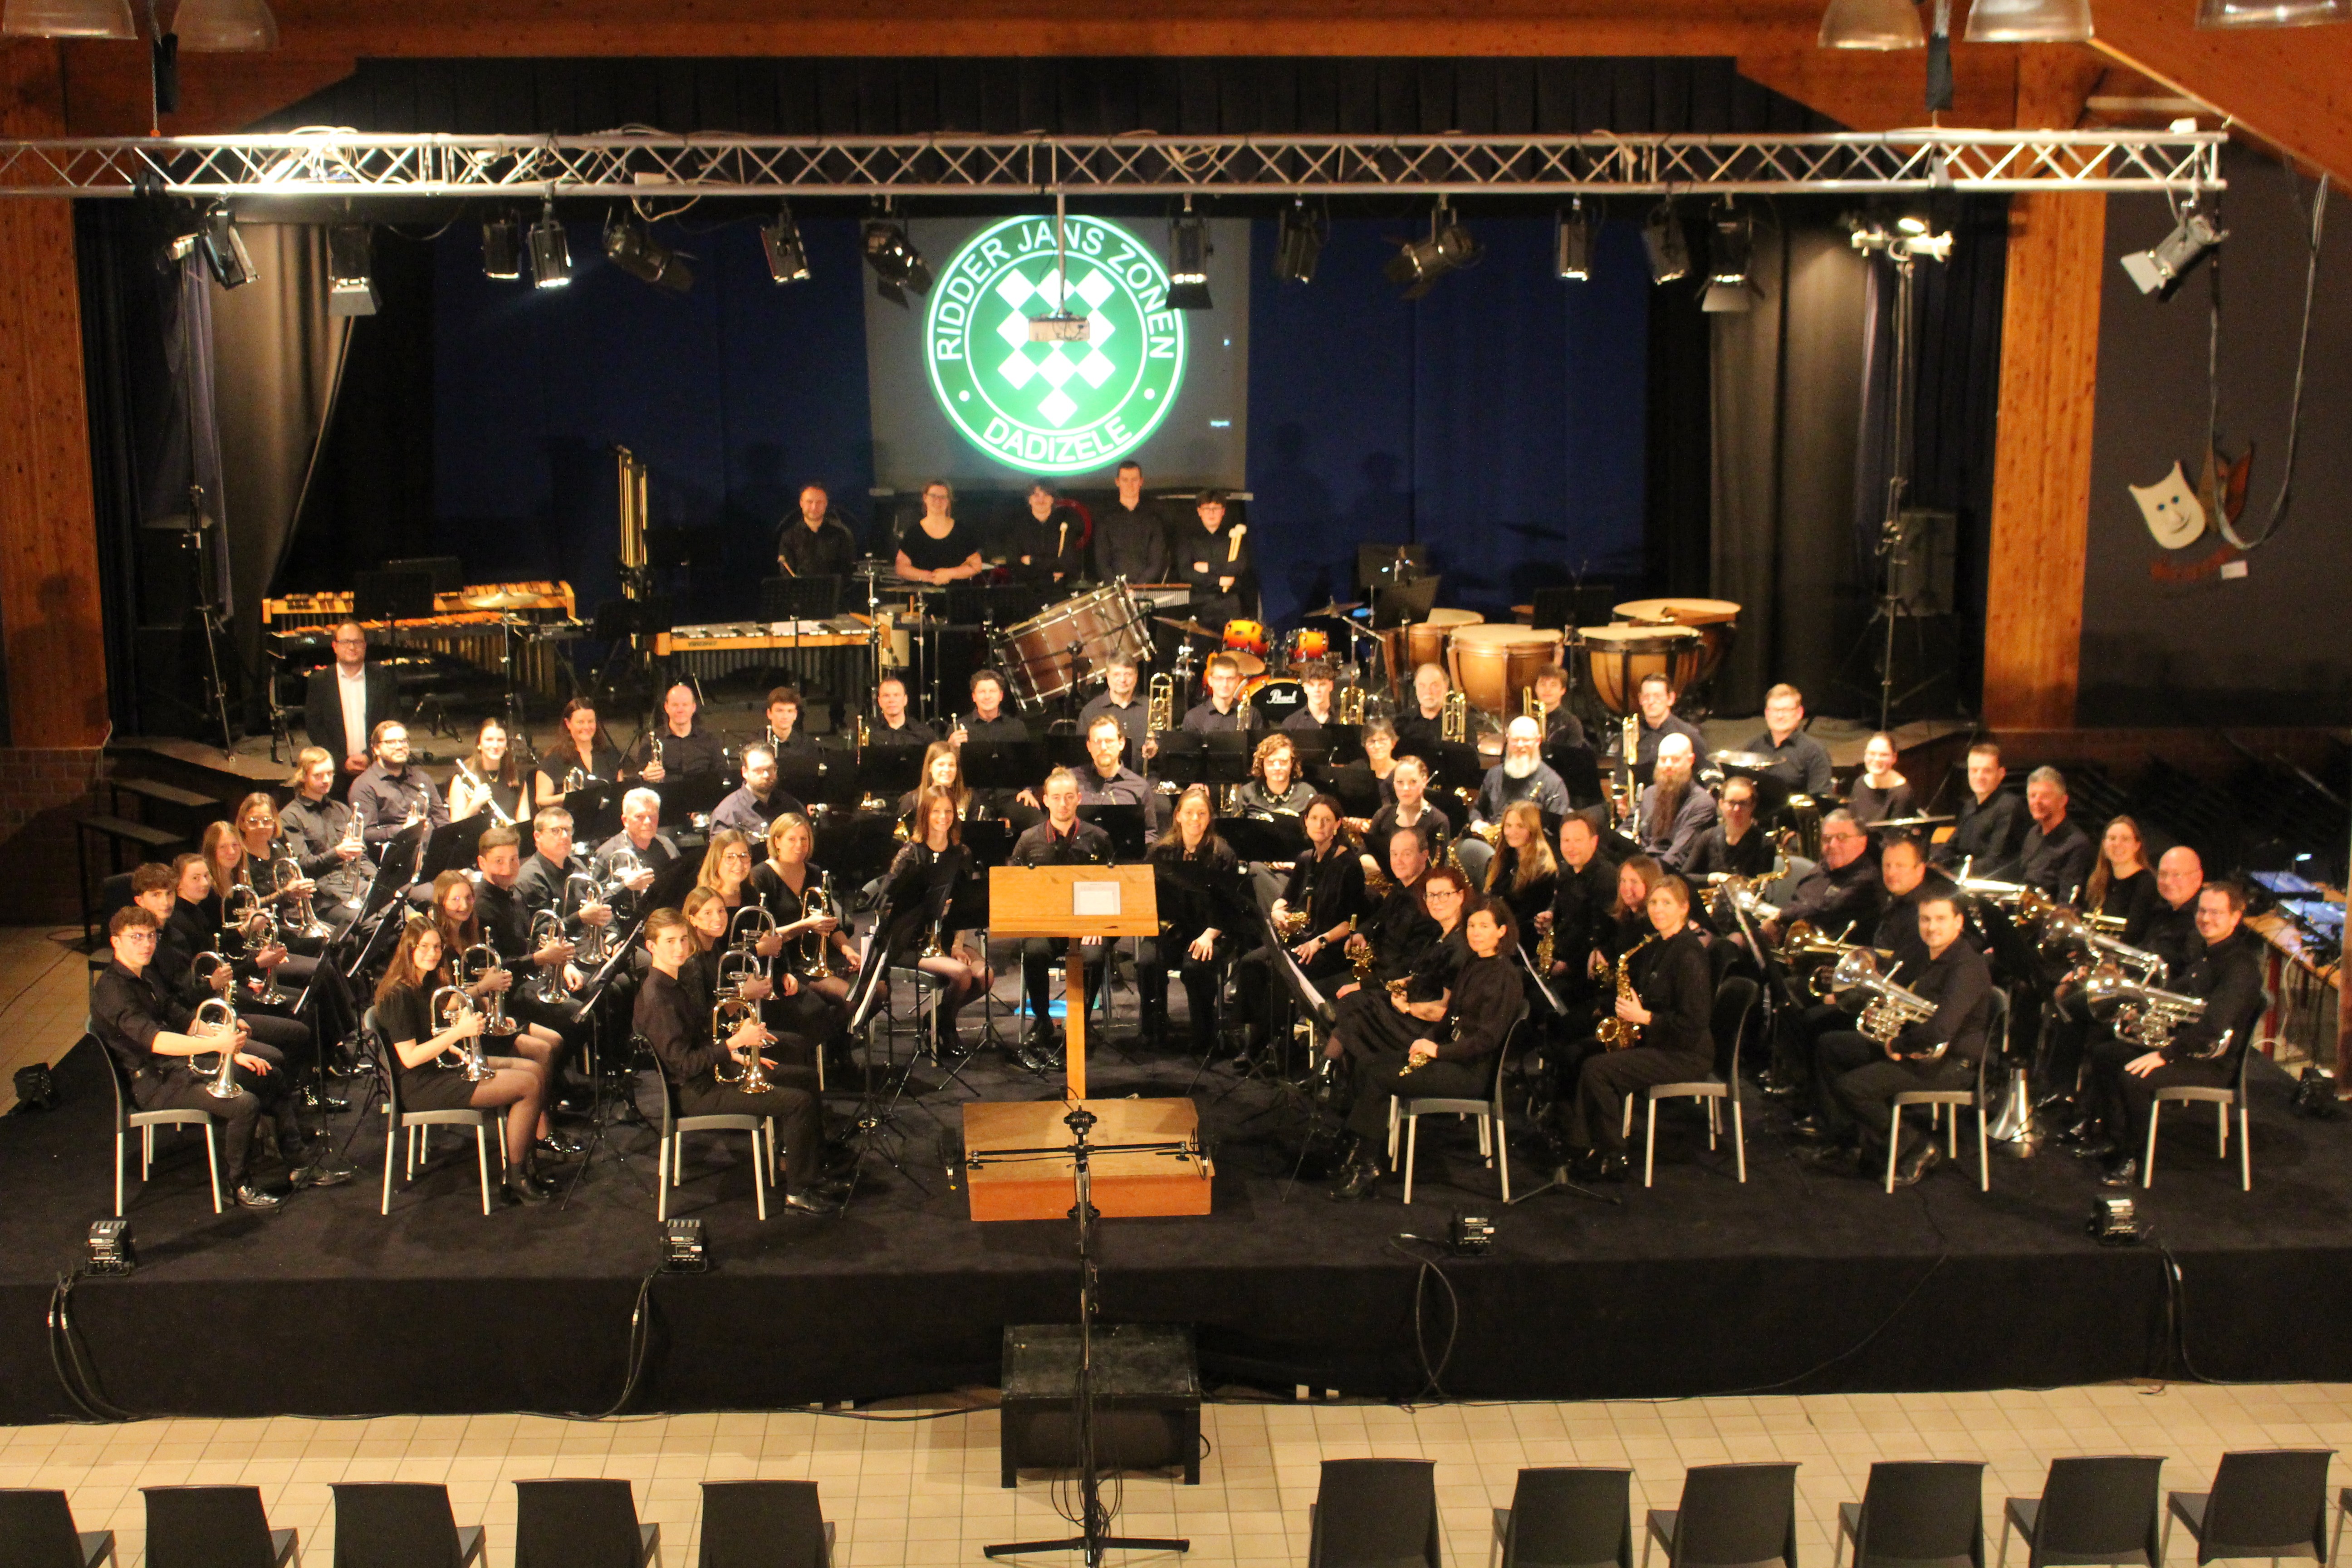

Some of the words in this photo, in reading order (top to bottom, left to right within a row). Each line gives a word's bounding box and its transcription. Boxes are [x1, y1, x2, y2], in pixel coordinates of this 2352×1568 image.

[936, 238, 1010, 360] RIDDER
[1017, 220, 1105, 255] JANS
[1107, 243, 1175, 358] ZONEN
[983, 416, 1132, 462] DADIZELE
[1266, 688, 1298, 704] Pearl
